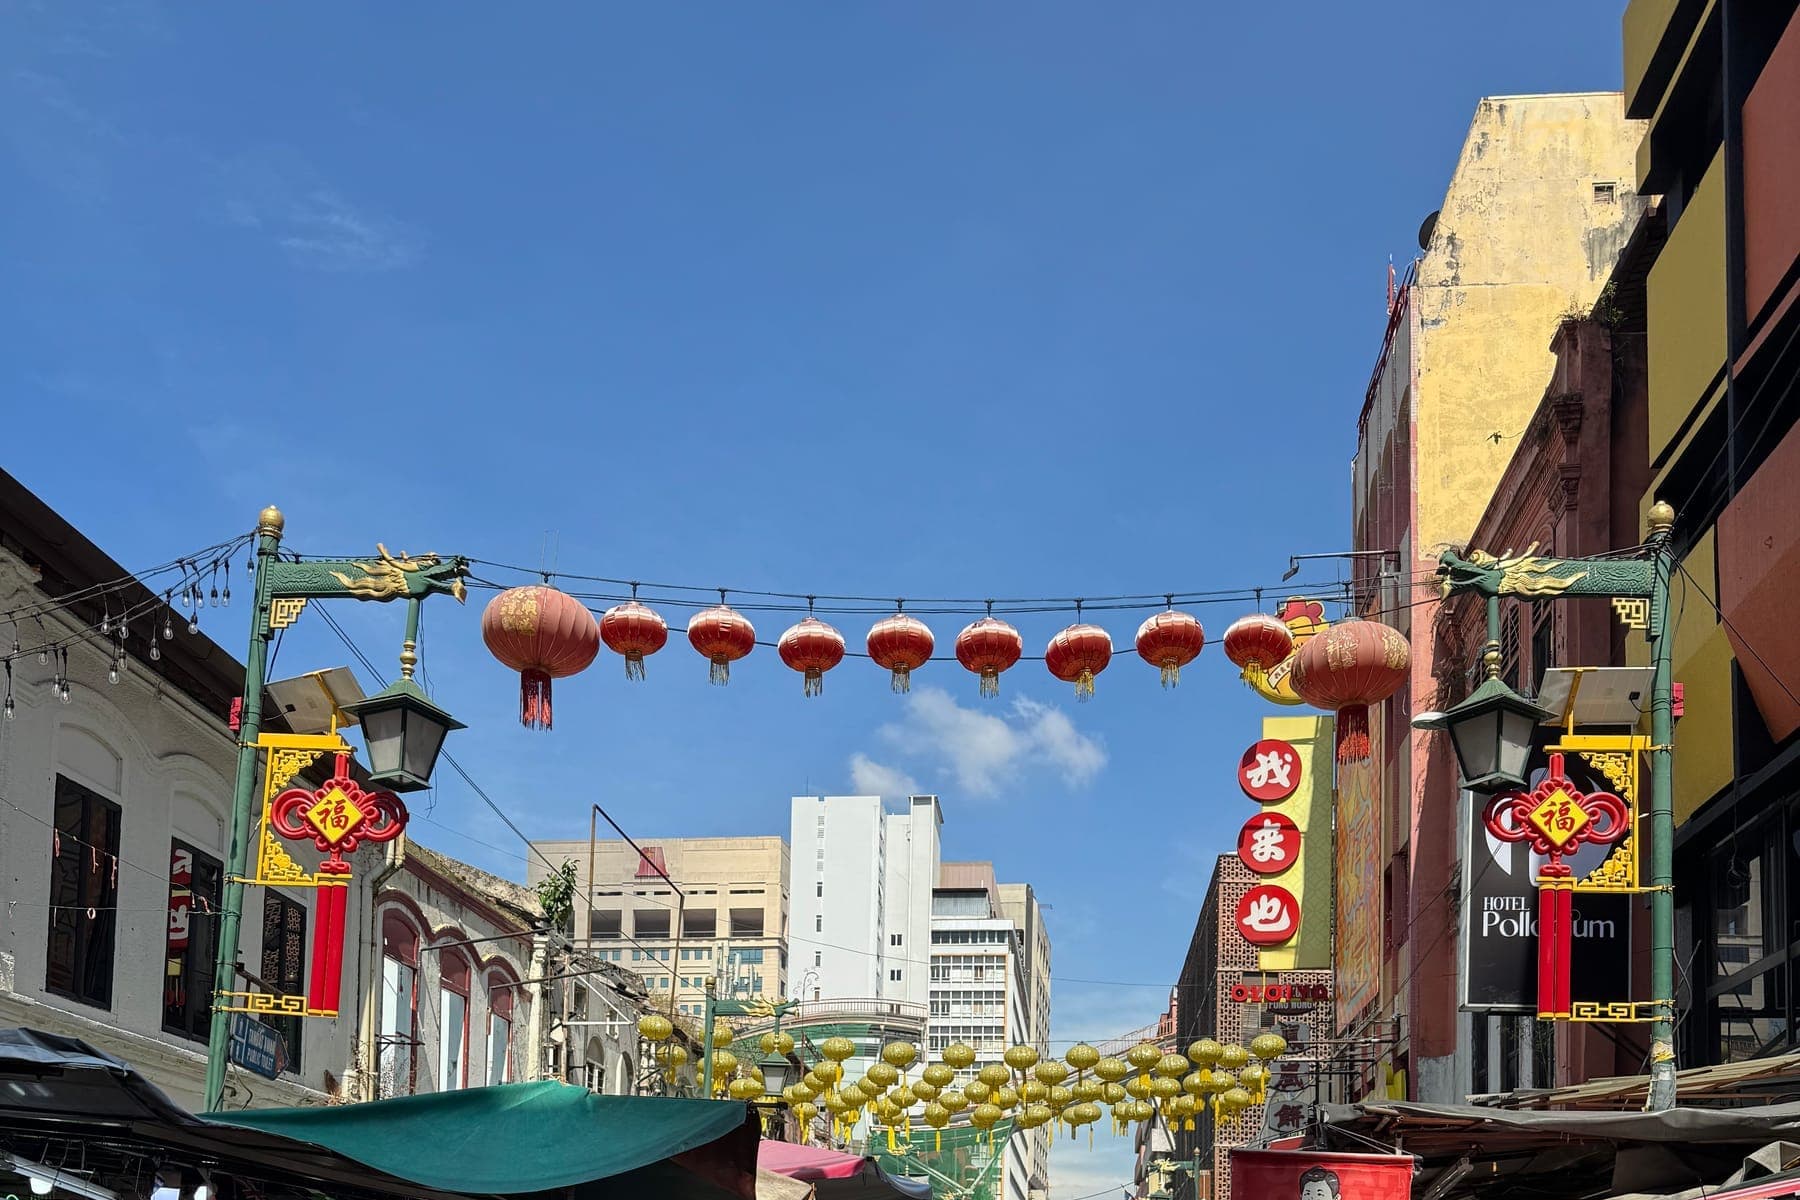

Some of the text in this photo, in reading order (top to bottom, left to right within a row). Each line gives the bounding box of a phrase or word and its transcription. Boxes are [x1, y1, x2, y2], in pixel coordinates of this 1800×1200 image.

[316, 799, 349, 830] 福
[1540, 801, 1575, 832] 福
[1483, 896, 1531, 911] HOTEL
